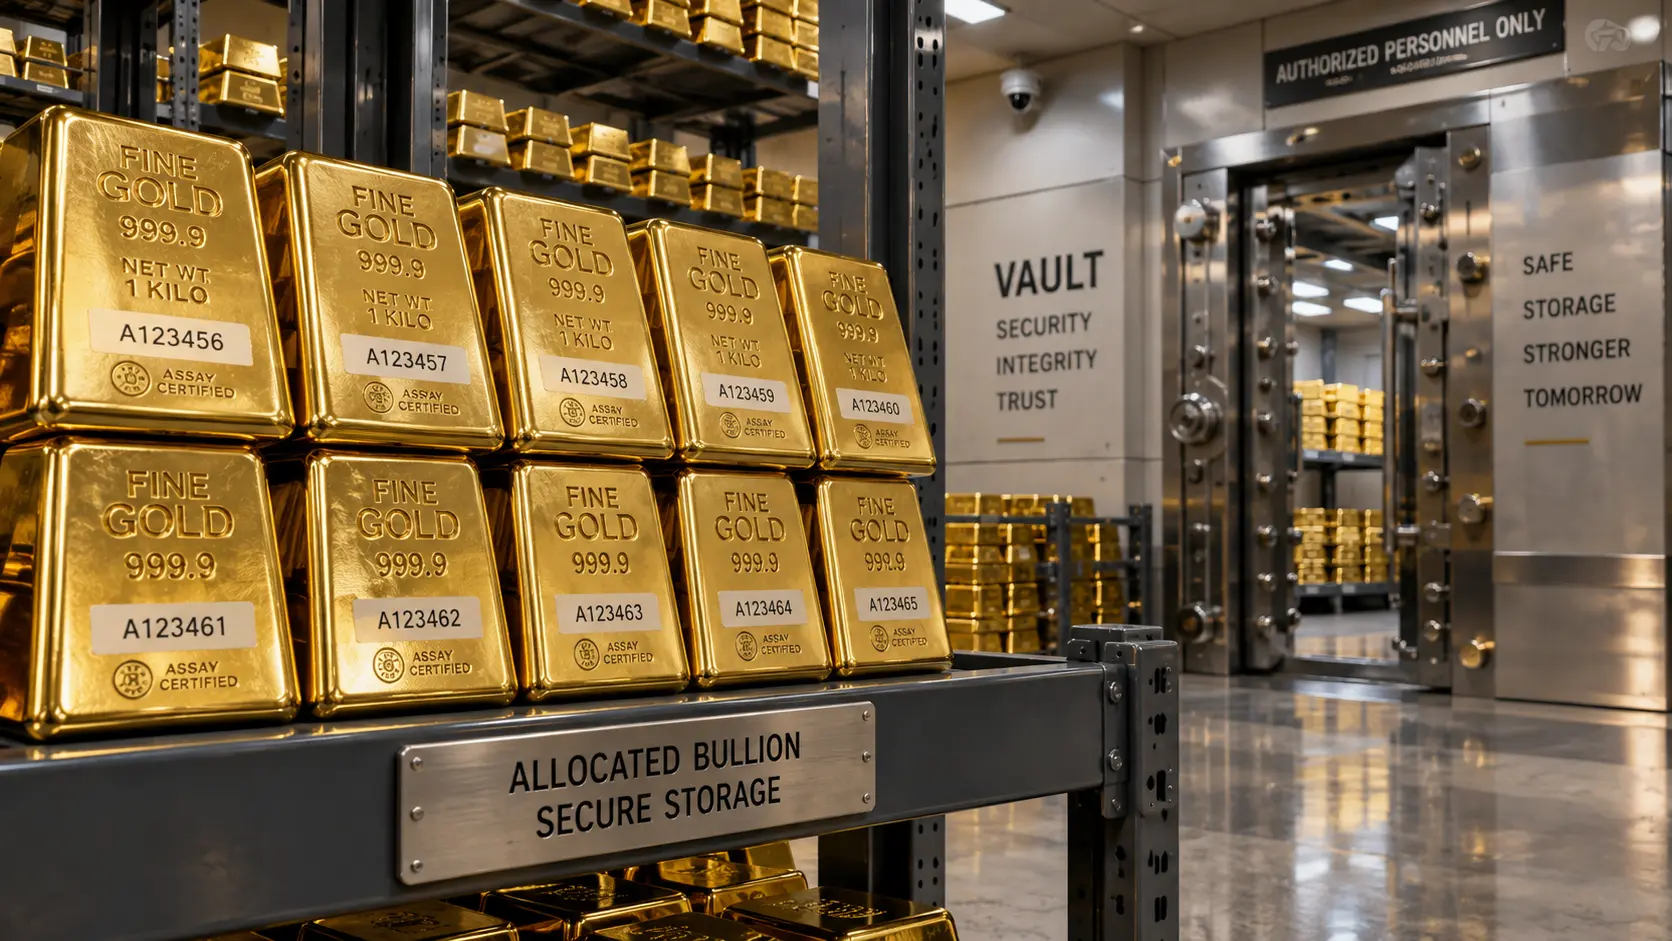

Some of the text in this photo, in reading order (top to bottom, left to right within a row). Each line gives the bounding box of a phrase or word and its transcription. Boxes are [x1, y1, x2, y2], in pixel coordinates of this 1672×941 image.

[1276, 44, 1379, 84] AUTHORIZED
[1385, 21, 1490, 62] PERSONNEL
[1495, 9, 1546, 38] ONLY
[120, 144, 199, 182] FINE
[96, 170, 224, 218] GOLD
[352, 185, 415, 218] FINE
[119, 215, 207, 249] 999.9
[336, 209, 438, 251] GOLD
[540, 218, 594, 247] FINE
[121, 257, 169, 278] NET
[357, 250, 426, 279] 999.9
[529, 240, 614, 277] GOLD
[697, 246, 743, 272] FINE
[1523, 252, 1573, 275] SAFE
[688, 266, 760, 300] GOLD
[828, 271, 868, 294] FINE
[994, 249, 1104, 299] VAULT
[126, 279, 210, 305] 1 KILO
[362, 289, 399, 307] NET
[549, 277, 605, 304] 999.9
[706, 302, 754, 325] 999.9
[822, 290, 884, 320] GOLD
[1523, 293, 1616, 319] STORAGE
[368, 308, 433, 330] 1 KILO
[554, 314, 583, 329] NET
[996, 312, 1092, 340] SECURITY
[120, 324, 224, 351] A123456
[560, 331, 614, 351] 1 KILO
[711, 335, 737, 348] NET
[837, 321, 879, 343] 999.9
[367, 348, 447, 372] A123457
[716, 351, 762, 368] 1 KILO
[844, 352, 865, 365] NET
[996, 349, 1098, 375] INTEGRITY
[1524, 338, 1630, 364] STRONGER
[163, 368, 217, 383] ASSAY
[561, 368, 628, 389] A123458
[860, 368, 888, 383] KILO
[157, 383, 236, 399] CERTIFIED
[403, 389, 444, 401] ASSAY
[719, 384, 775, 403] A123459
[996, 389, 1058, 411] TRUST
[1523, 383, 1643, 408] TOMORROW
[399, 400, 461, 415] CERTIFIED
[592, 404, 623, 415] ASSAY
[852, 398, 900, 416] A123460
[589, 415, 639, 428] CERTIFIED
[746, 418, 773, 427] ASSAY
[745, 427, 786, 439] CERTIFIED
[876, 429, 898, 438] ASSAY
[126, 470, 210, 500] FINE
[372, 479, 438, 505] FINE
[566, 486, 620, 509] FINE
[724, 492, 770, 513] FINE
[857, 497, 895, 516] FINE
[102, 503, 235, 539] GOLD
[357, 507, 460, 540] GOLD
[554, 512, 639, 541] GOLD
[715, 515, 786, 542] GOLD
[850, 518, 910, 543] GOLD
[124, 552, 217, 581] 999.9
[376, 552, 448, 578] 999.9
[572, 552, 631, 574] 999.9
[731, 552, 779, 573] 999.9
[864, 552, 906, 572] 999.9
[576, 604, 642, 622] A123463
[736, 600, 792, 617] A123464
[870, 597, 917, 612] A123465
[123, 616, 225, 639] A123461
[378, 608, 461, 630] A123462
[763, 634, 789, 643] ASSAY
[892, 637, 927, 647] CERTIFIED
[894, 628, 916, 636] ASSAY
[413, 650, 453, 662] ASSAY
[607, 641, 638, 651] ASSAY
[761, 644, 802, 655] CERTIFIED
[166, 661, 219, 675] ASSAY
[409, 662, 472, 676] CERTIFIED
[604, 652, 654, 664] CERTIFIED
[159, 675, 239, 690] CERTIFIED
[508, 731, 801, 795] ALLOCATED BULLION
[536, 775, 781, 839] SECURE STORAGE
